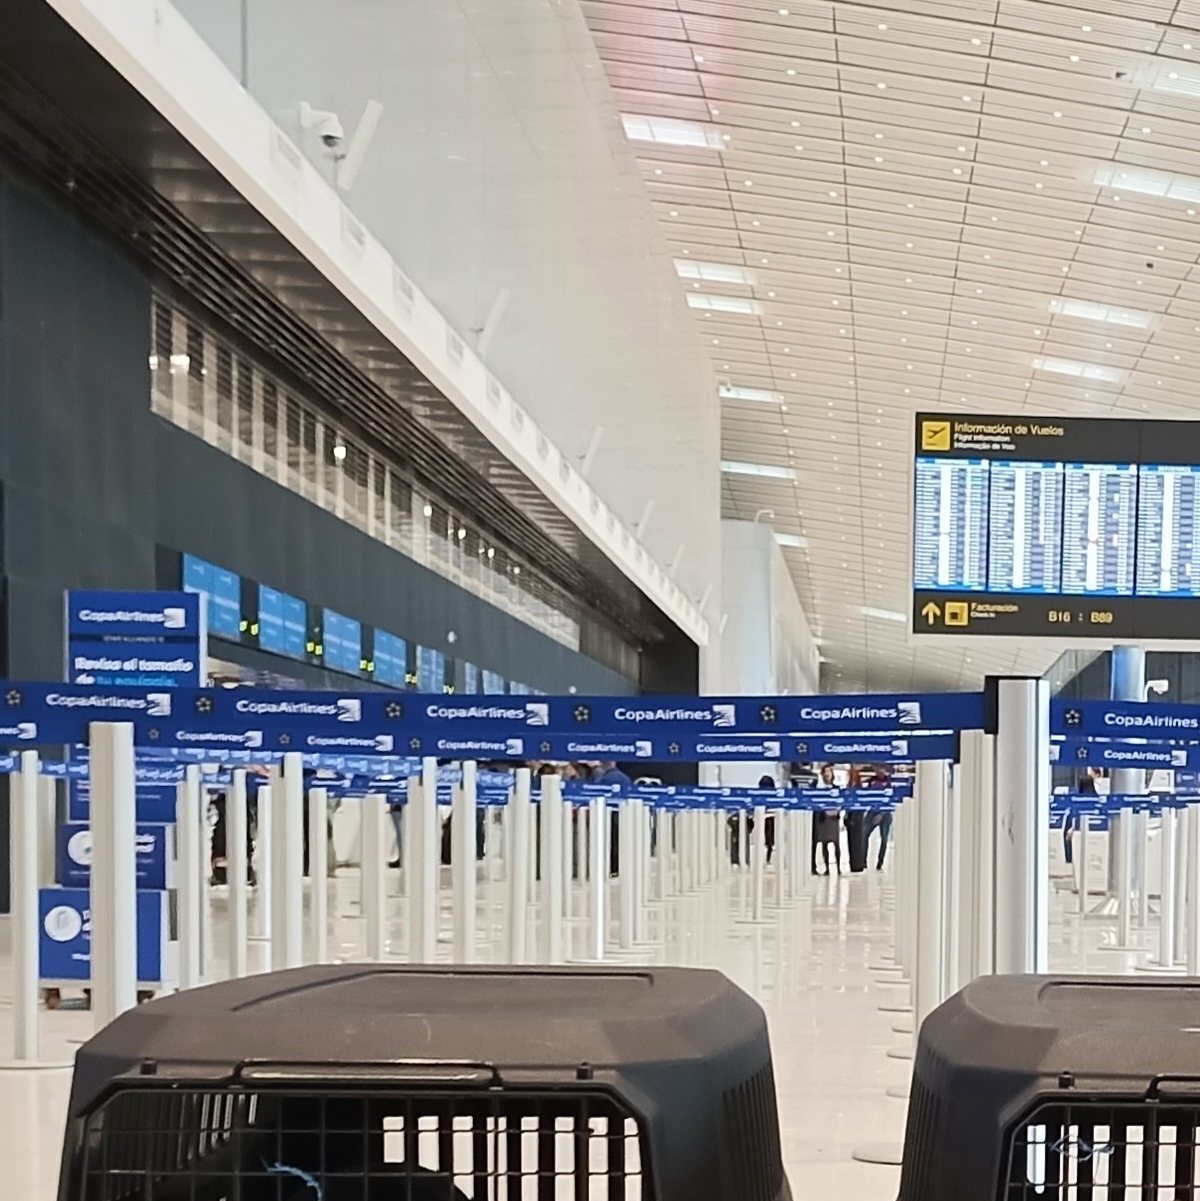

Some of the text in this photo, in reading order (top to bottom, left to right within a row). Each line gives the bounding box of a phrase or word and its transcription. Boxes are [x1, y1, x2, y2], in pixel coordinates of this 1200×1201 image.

[954, 422, 1064, 437] Información de Vuelos
[46, 693, 898, 722] CopaAirlines CopaAirlines CopaAirlines CopaAirlines CopaAirlines
[1104, 713, 1199, 728] CopaAirlines
[437, 739, 506, 751] CopaAirlines
[567, 742, 635, 753] CopaAirlines
[696, 743, 764, 754] CopaAirlines
[823, 743, 892, 753] CopaAirlines
[1103, 749, 1172, 762] CopaAirlines
